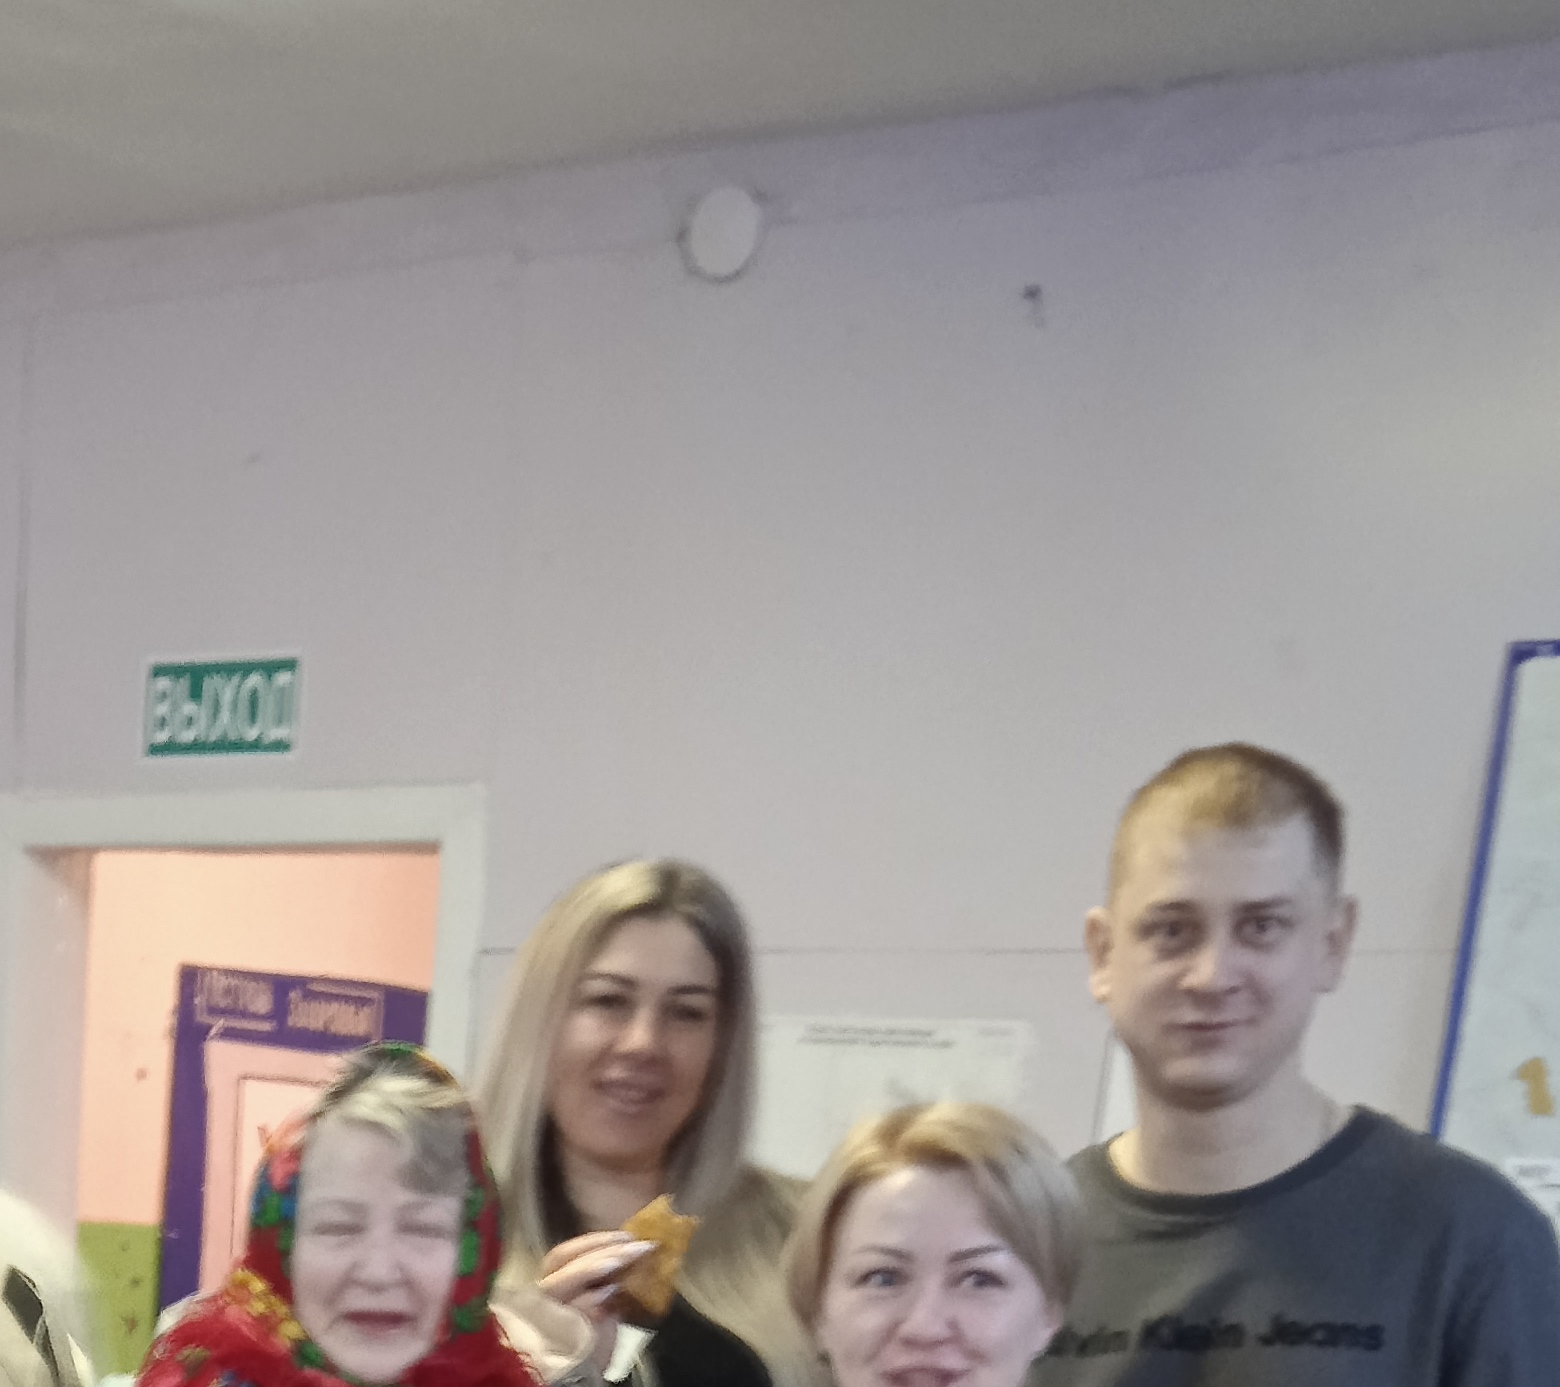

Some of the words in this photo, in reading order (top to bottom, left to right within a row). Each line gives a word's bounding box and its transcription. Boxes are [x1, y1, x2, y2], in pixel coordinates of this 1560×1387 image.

[149, 670, 297, 744] ВЫХОД
[1140, 1317, 1244, 1354] Klein
[1257, 1313, 1386, 1350] Jeans
